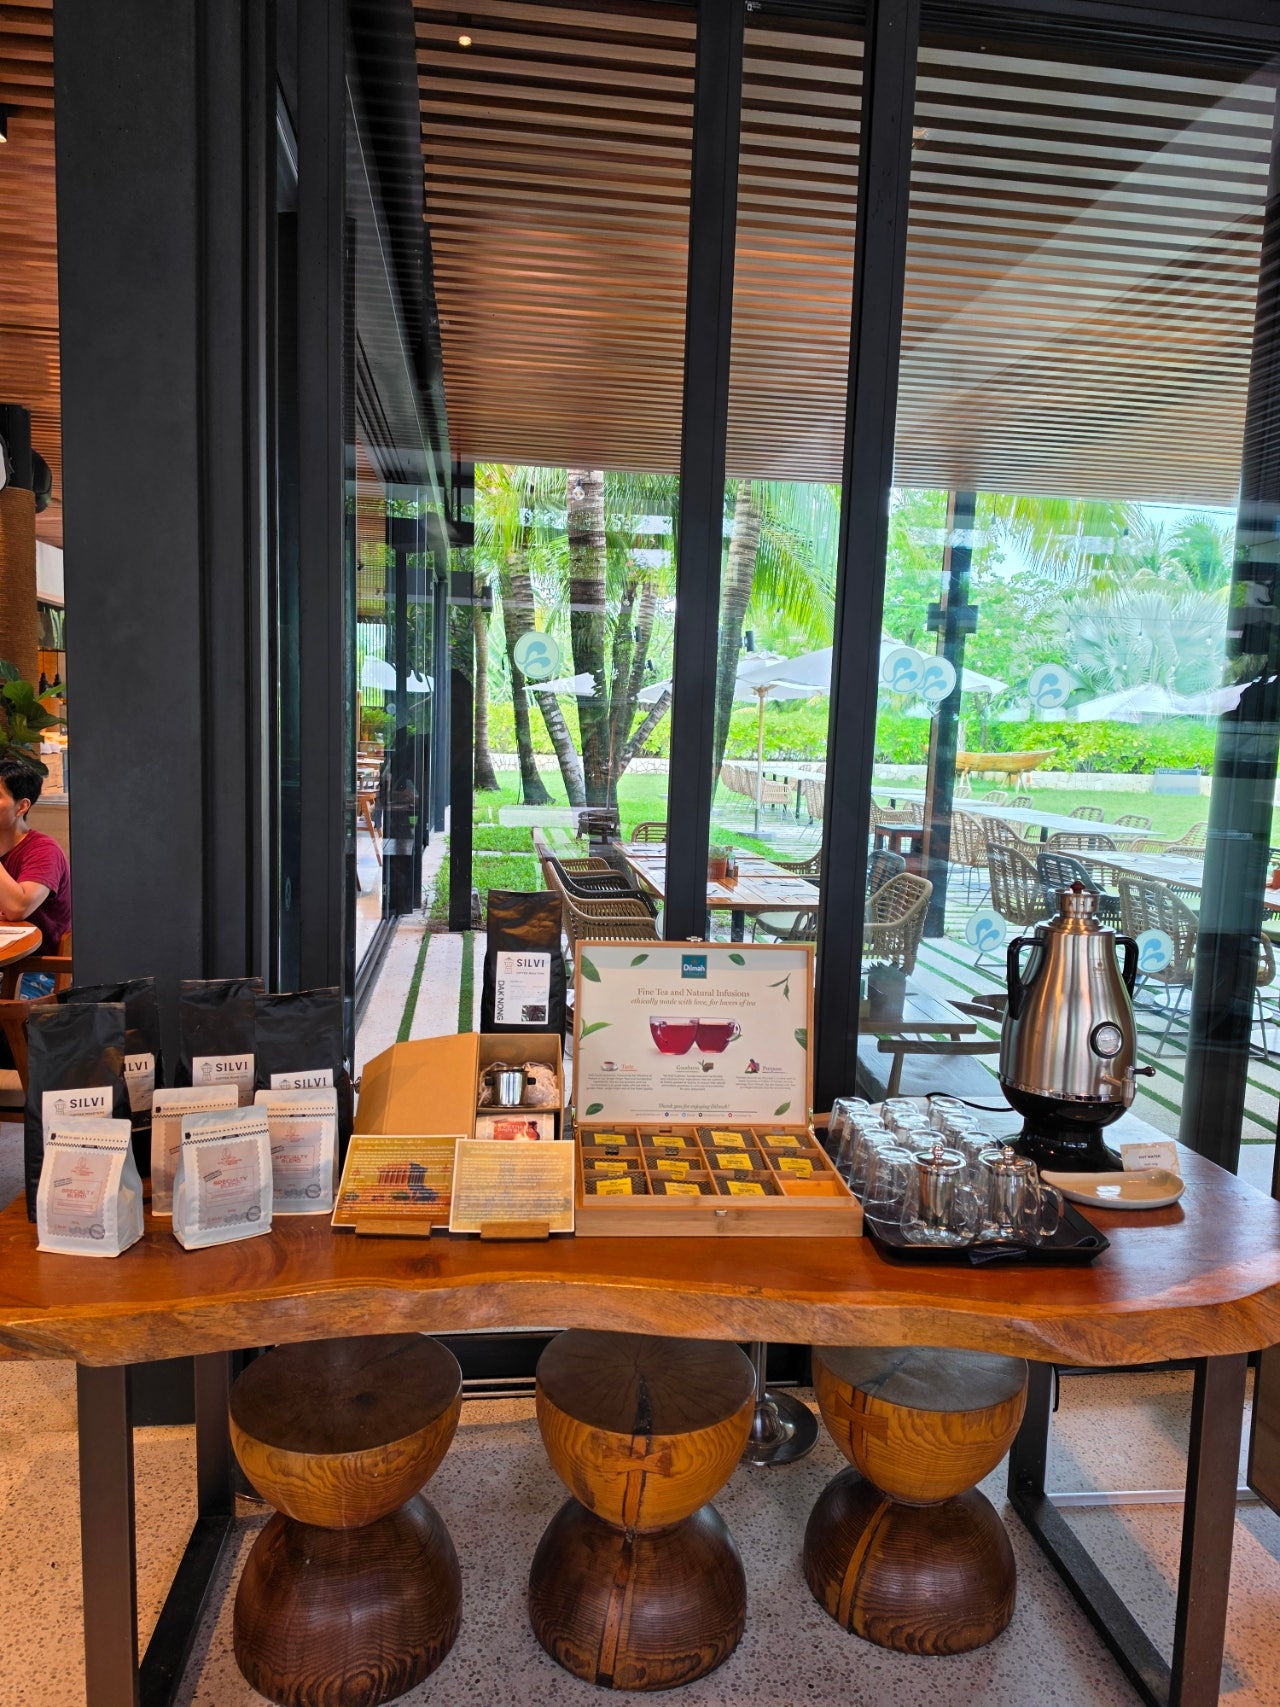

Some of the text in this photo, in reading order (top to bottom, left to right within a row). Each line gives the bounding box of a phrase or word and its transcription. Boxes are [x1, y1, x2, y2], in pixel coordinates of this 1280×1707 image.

[516, 958, 545, 968] SILVI
[683, 964, 706, 972] Dilmah
[637, 988, 654, 996] Fine
[655, 988, 668, 996] Tea
[686, 989, 714, 997] Natural
[716, 989, 750, 998] Infusions
[496, 980, 505, 1021] DAK NONG
[630, 997, 658, 1006] ethically
[677, 998, 692, 1006] with
[693, 998, 708, 1006] love,
[708, 998, 718, 1007] for
[124, 1061, 148, 1072] ILVI
[215, 1061, 248, 1072] SILVI
[294, 1077, 326, 1089] SILVI
[69, 1096, 104, 1109] SILVI
[213, 1176, 248, 1185] SPECIALTY
[61, 1188, 95, 1196] SPECIALTY
